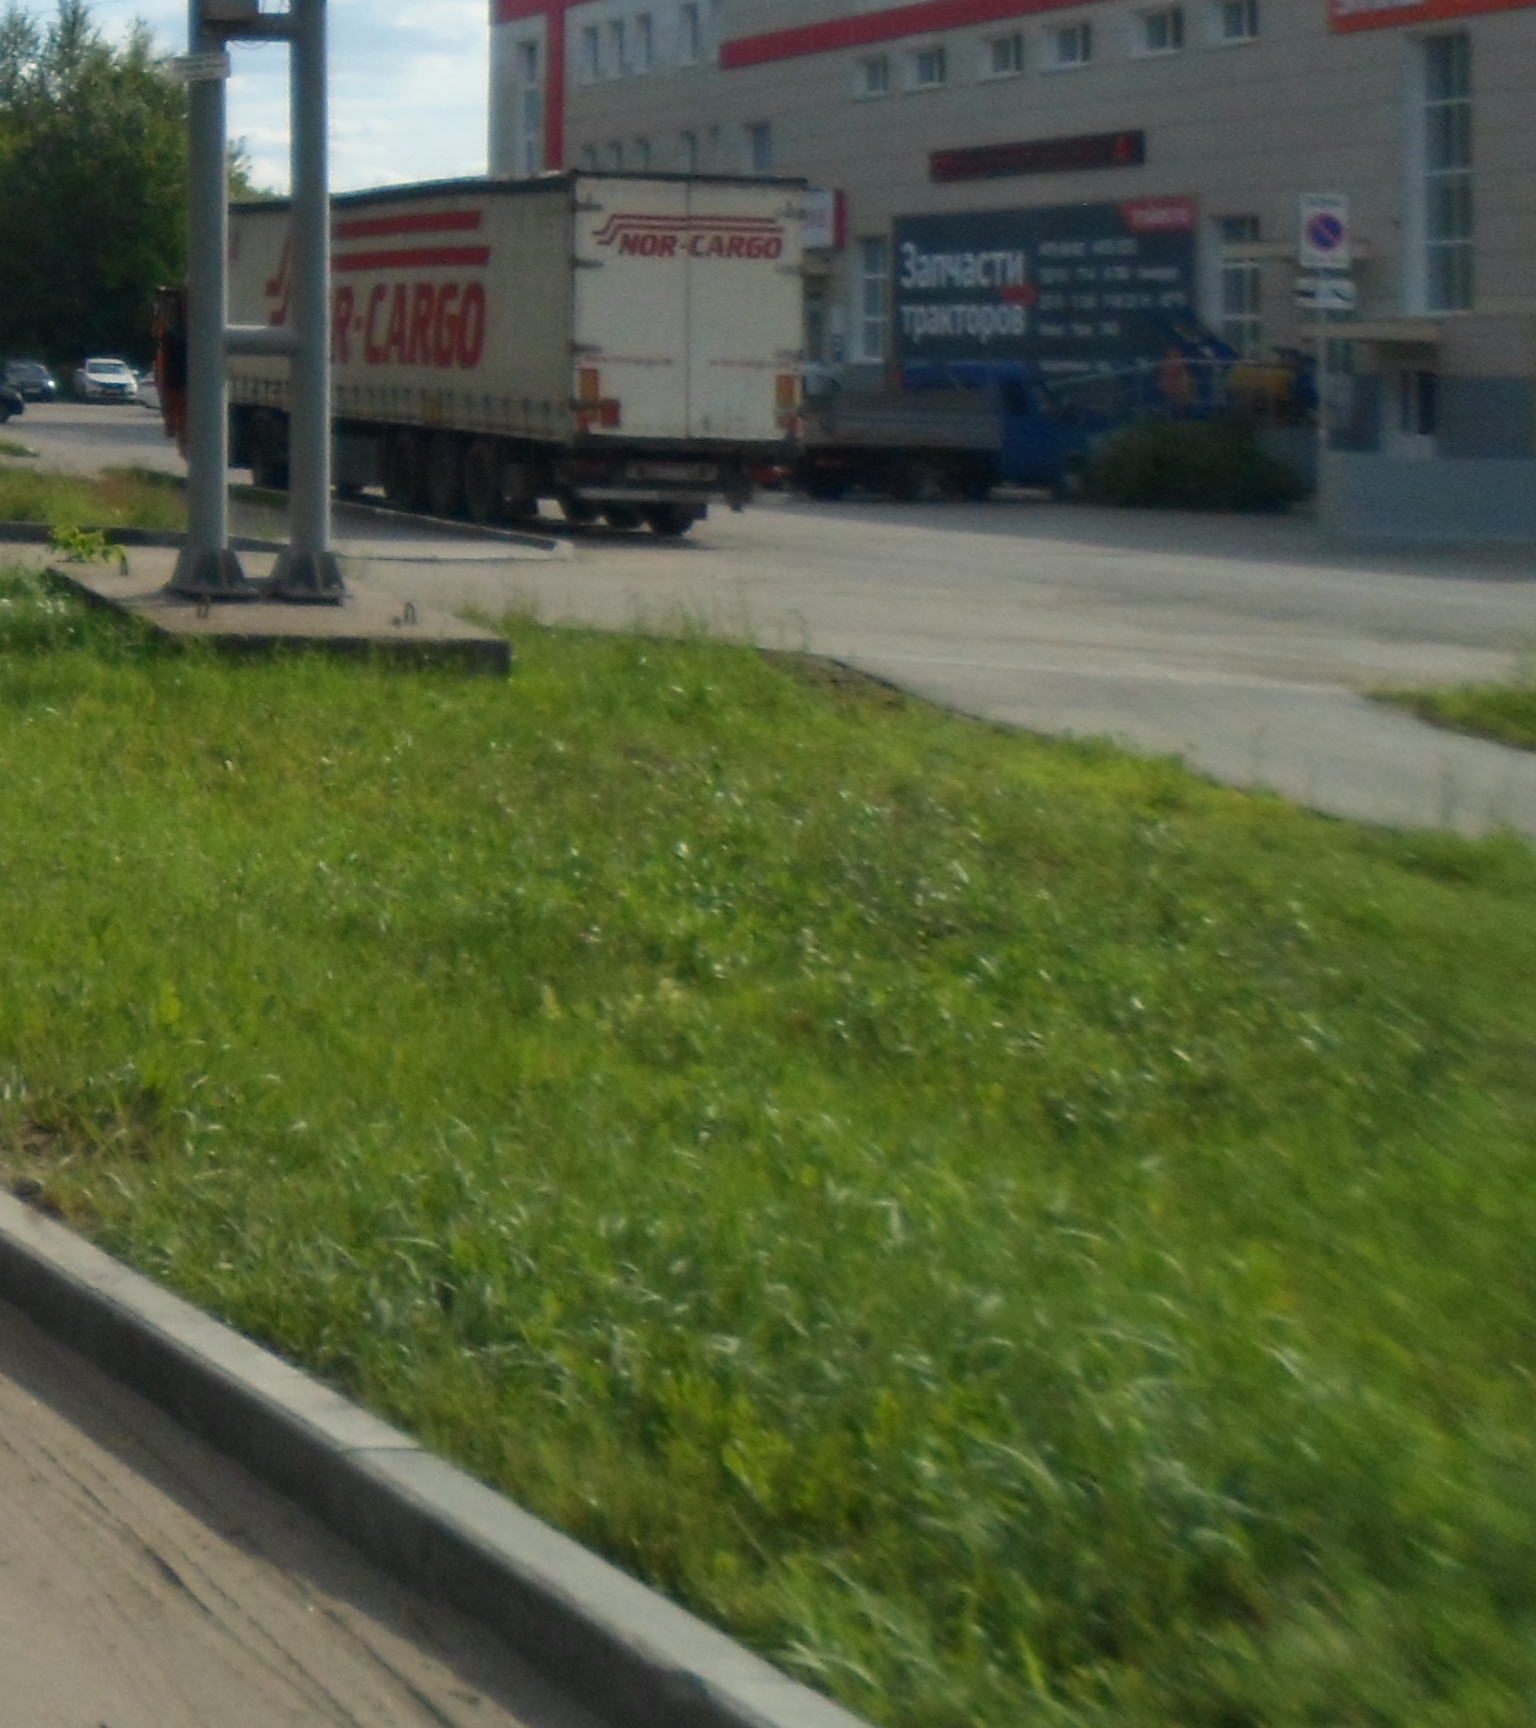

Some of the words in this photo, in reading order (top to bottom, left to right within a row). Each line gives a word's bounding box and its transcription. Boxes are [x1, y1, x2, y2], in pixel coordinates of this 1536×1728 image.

[619, 232, 782, 260] NOR-CARGO
[901, 242, 1025, 289] Запчасти
[901, 304, 1026, 343] тракторов
